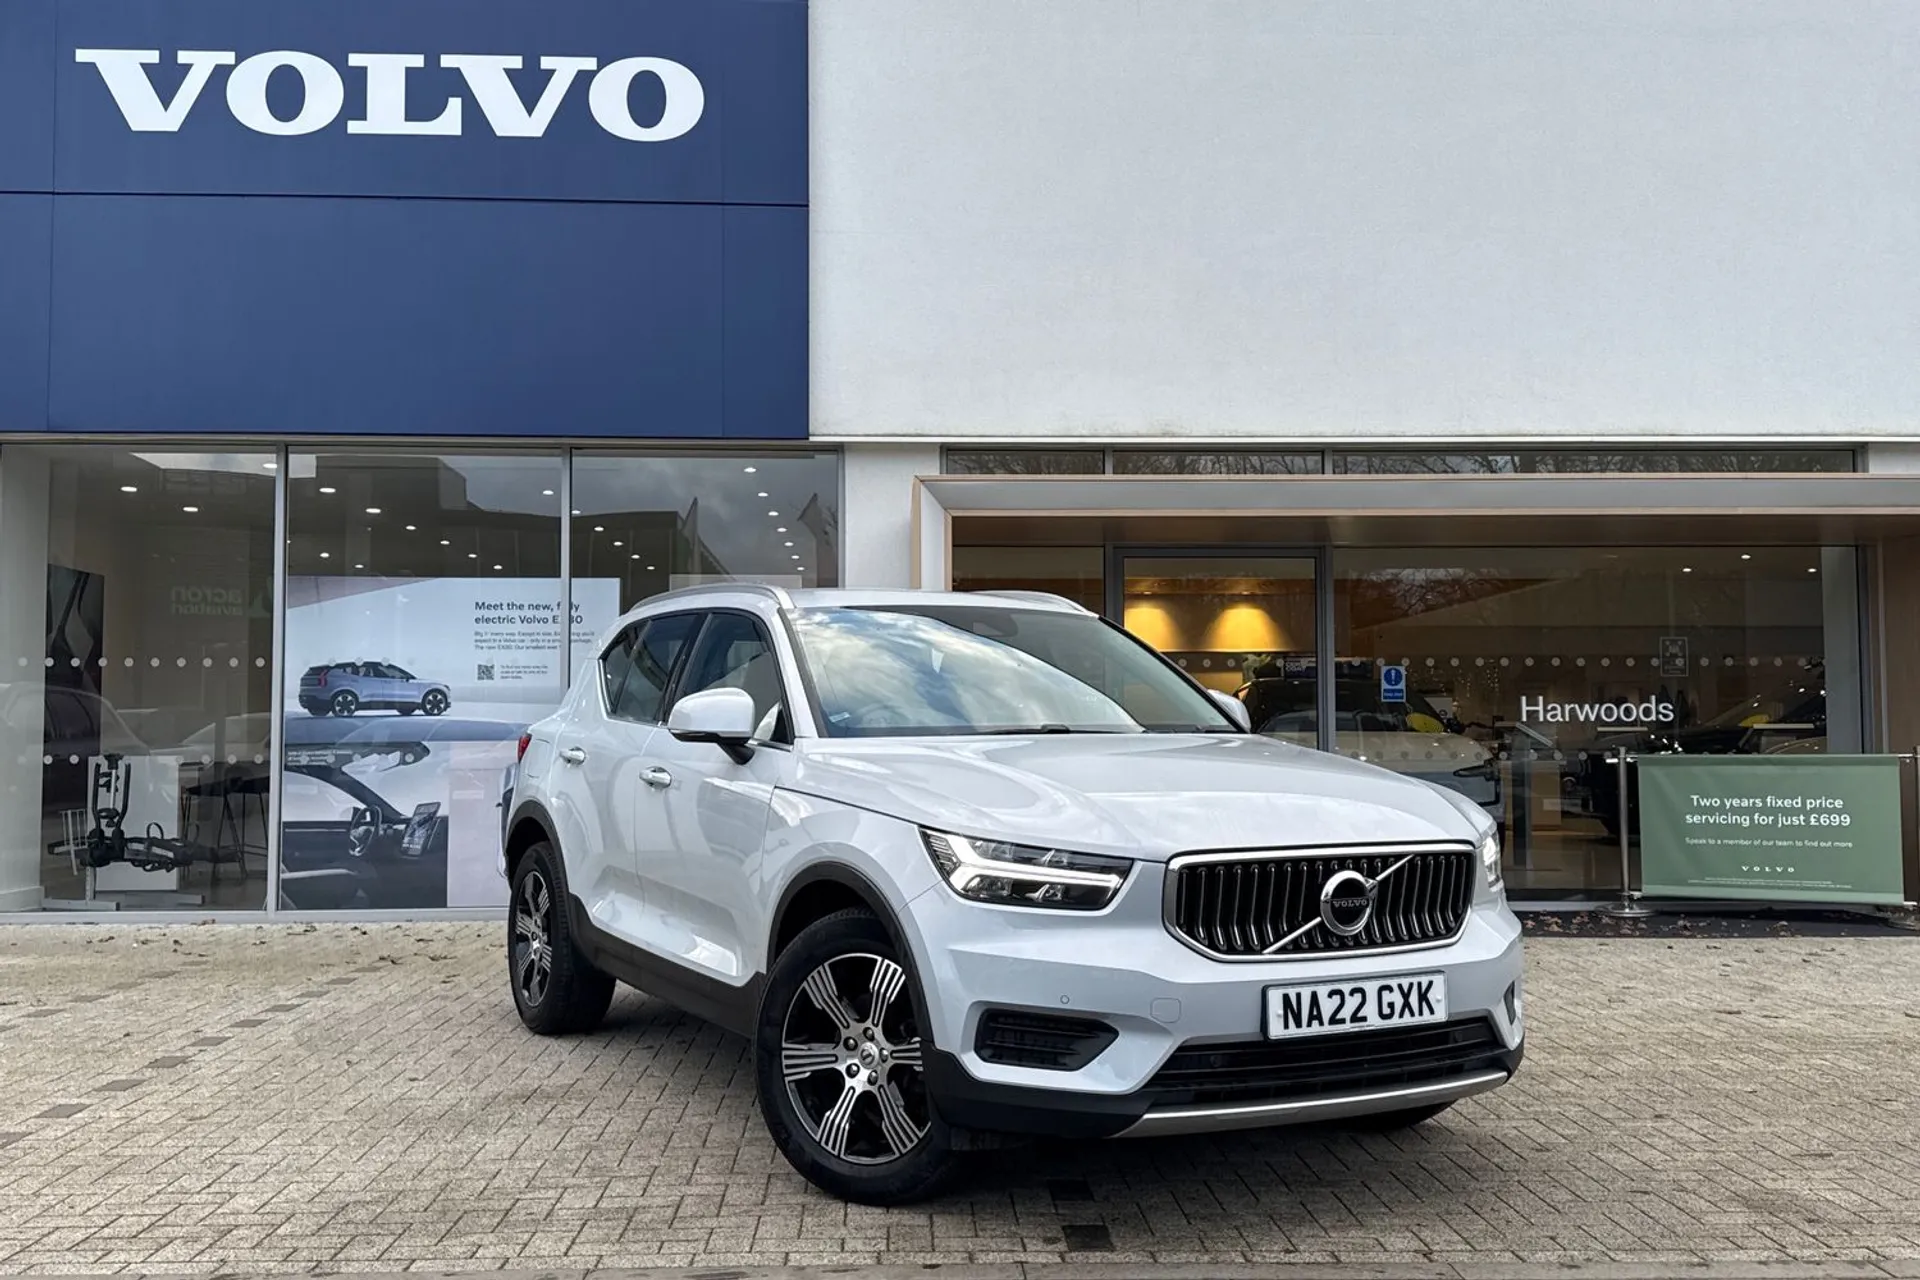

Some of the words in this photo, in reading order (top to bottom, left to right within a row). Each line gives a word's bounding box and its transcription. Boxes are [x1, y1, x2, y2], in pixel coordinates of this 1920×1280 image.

[74, 48, 705, 142] VOLVO
[474, 601, 504, 611] Meet
[506, 601, 525, 611] the
[527, 603, 554, 612] new,
[474, 614, 516, 625] electric
[518, 614, 549, 625] Volvo
[1520, 695, 1675, 722] Harwoods
[1690, 795, 1720, 808] Two
[1724, 797, 1763, 810] years
[1766, 796, 1801, 808] fixed
[1806, 797, 1844, 811] price
[1685, 812, 1750, 827] servicing
[1753, 813, 1775, 826] for
[1777, 813, 1806, 828] just
[1809, 813, 1851, 827] £699
[1685, 837, 1707, 846] Speak
[1723, 838, 1752, 846] member
[1741, 865, 1795, 873] VOLVO
[1332, 899, 1368, 908] VOLVO
[1282, 986, 1368, 1031] NA22
[1377, 979, 1436, 1021] GXK
